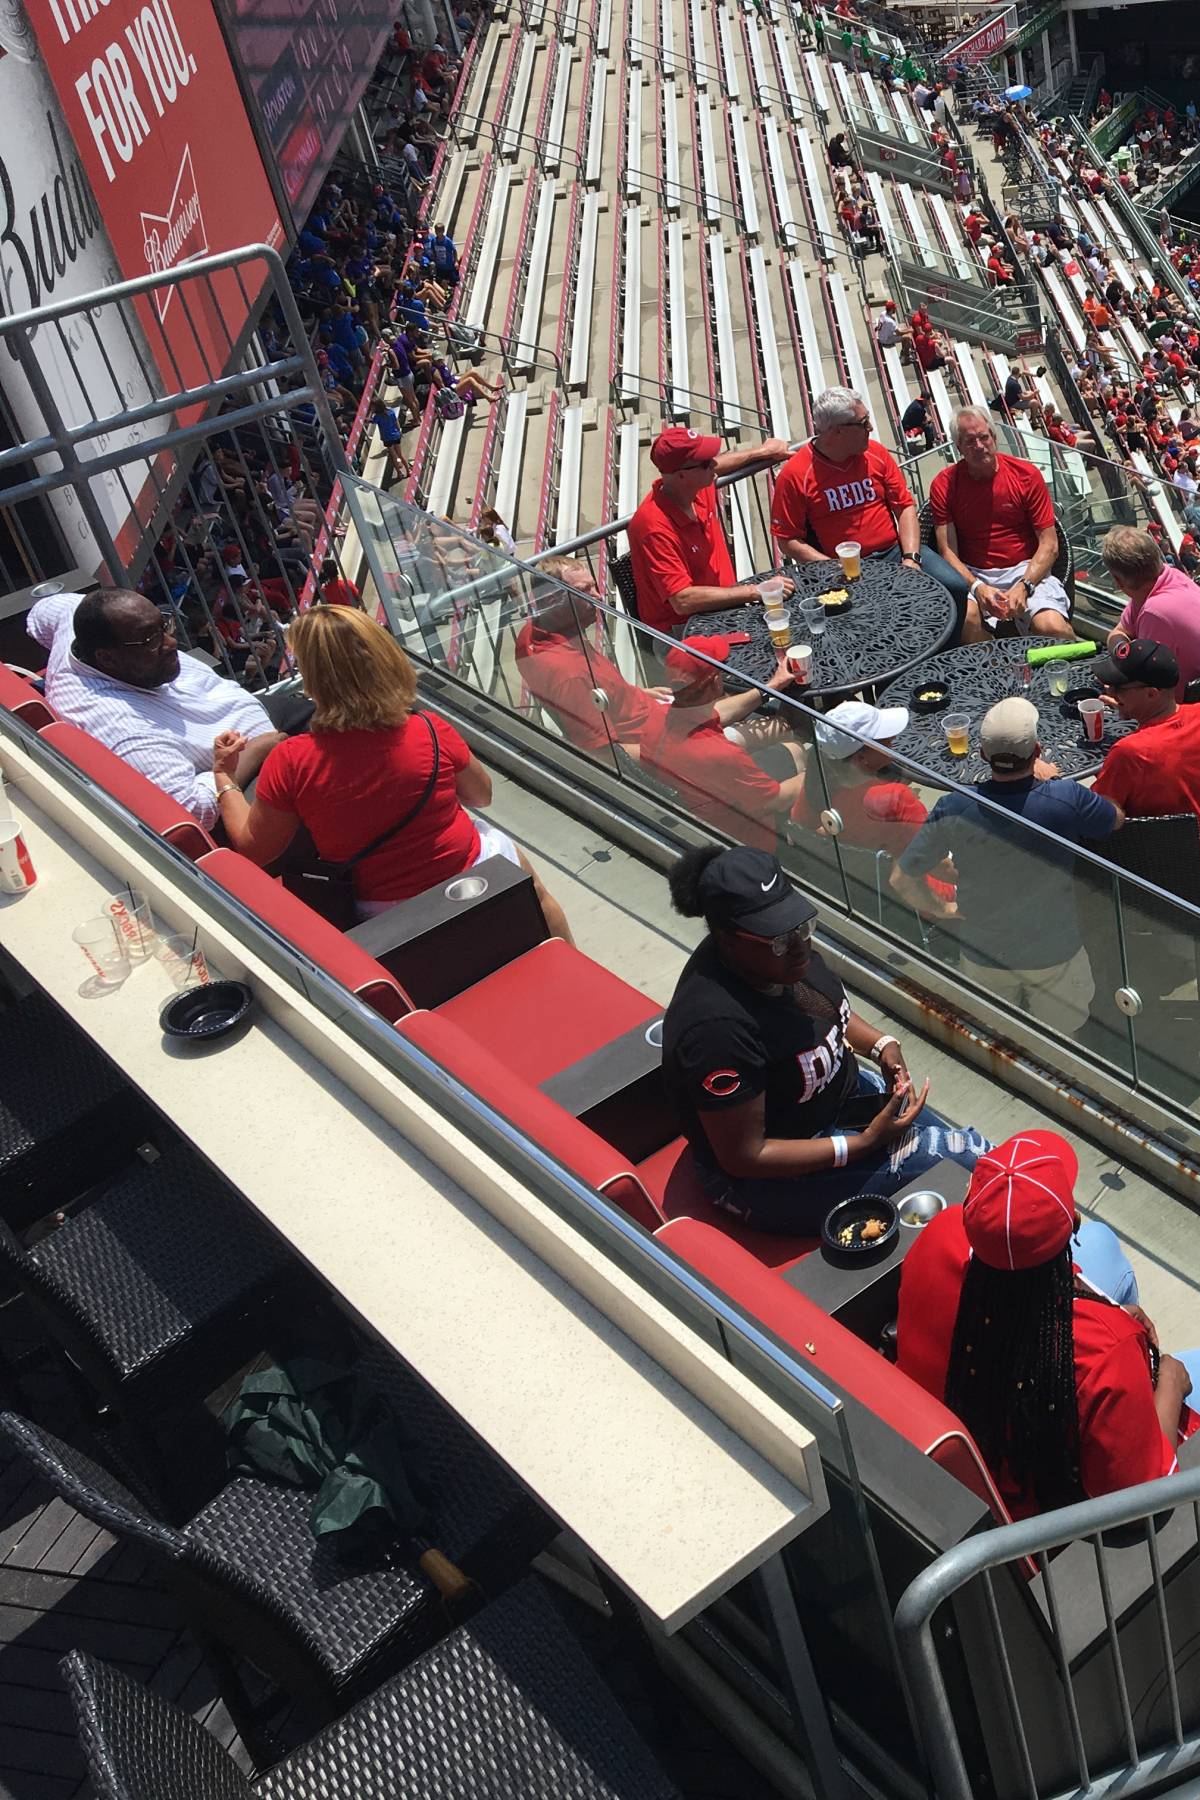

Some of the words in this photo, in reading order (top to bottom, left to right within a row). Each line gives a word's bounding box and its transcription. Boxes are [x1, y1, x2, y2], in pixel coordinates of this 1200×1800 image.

[986, 23, 1004, 49] PATIO
[75, 41, 151, 183] FOR
[124, 0, 198, 118] YOU.
[143, 193, 201, 275] Budweiser
[824, 478, 877, 512] REDS
